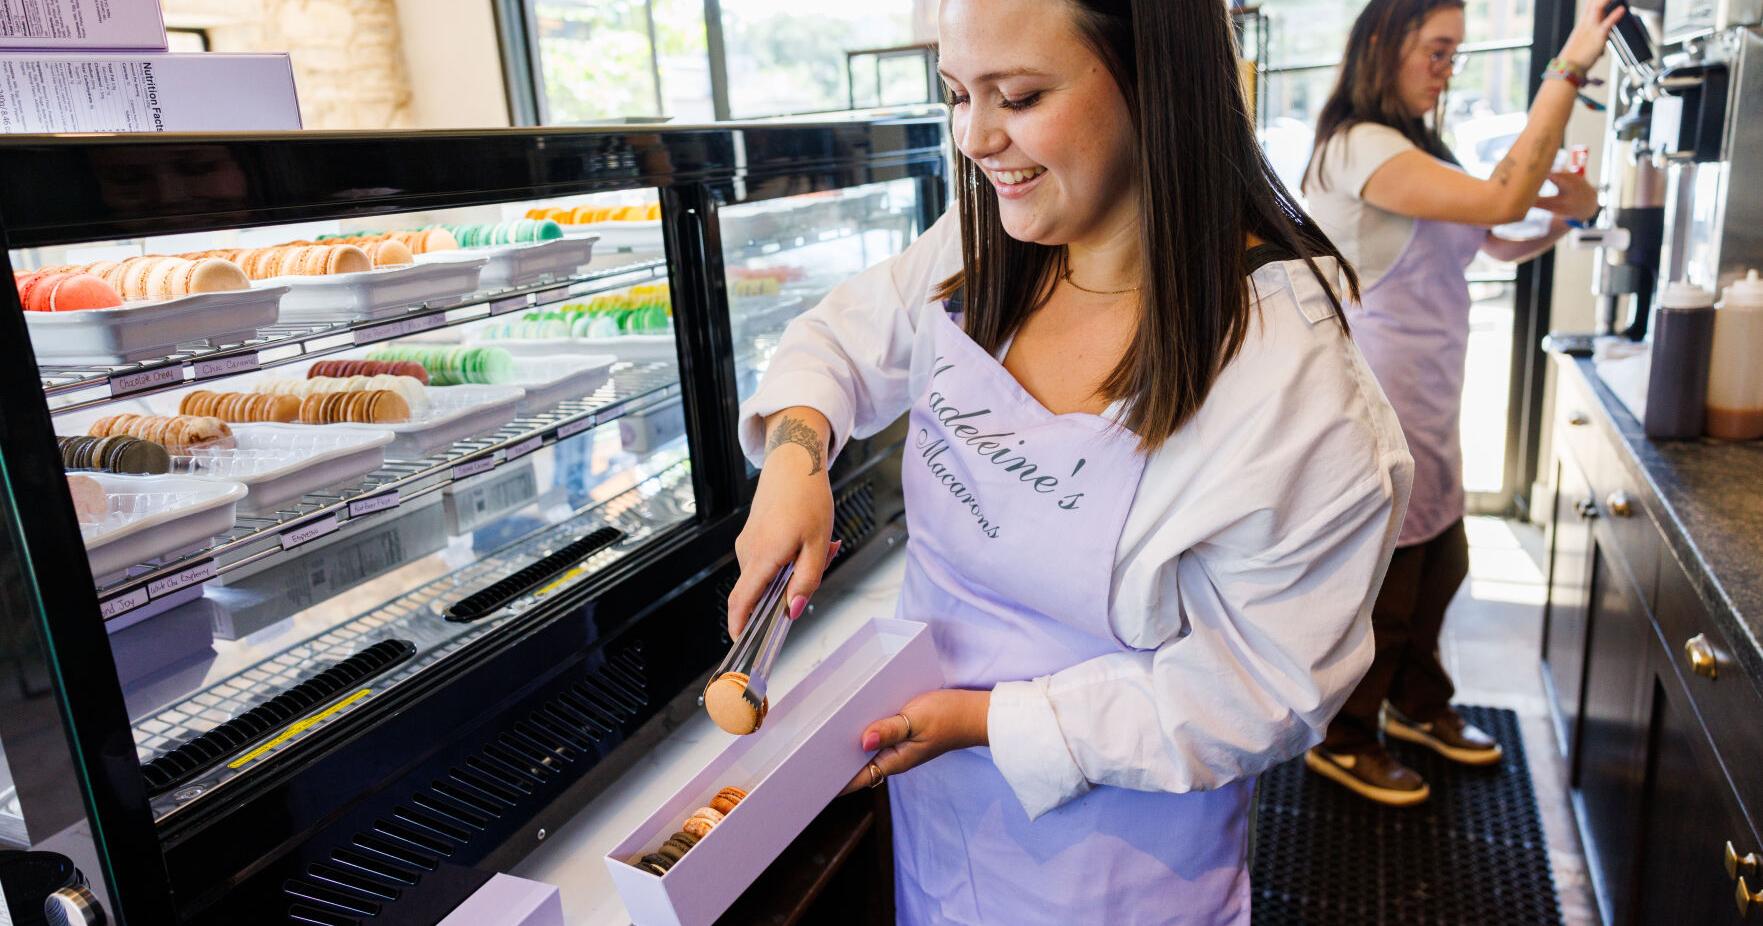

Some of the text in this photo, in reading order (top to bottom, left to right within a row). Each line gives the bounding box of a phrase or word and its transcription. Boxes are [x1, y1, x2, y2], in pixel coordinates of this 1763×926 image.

[143, 62, 164, 132] Nutrition Facts
[916, 428, 1000, 539] Macarons
[119, 599, 135, 611] Joy
